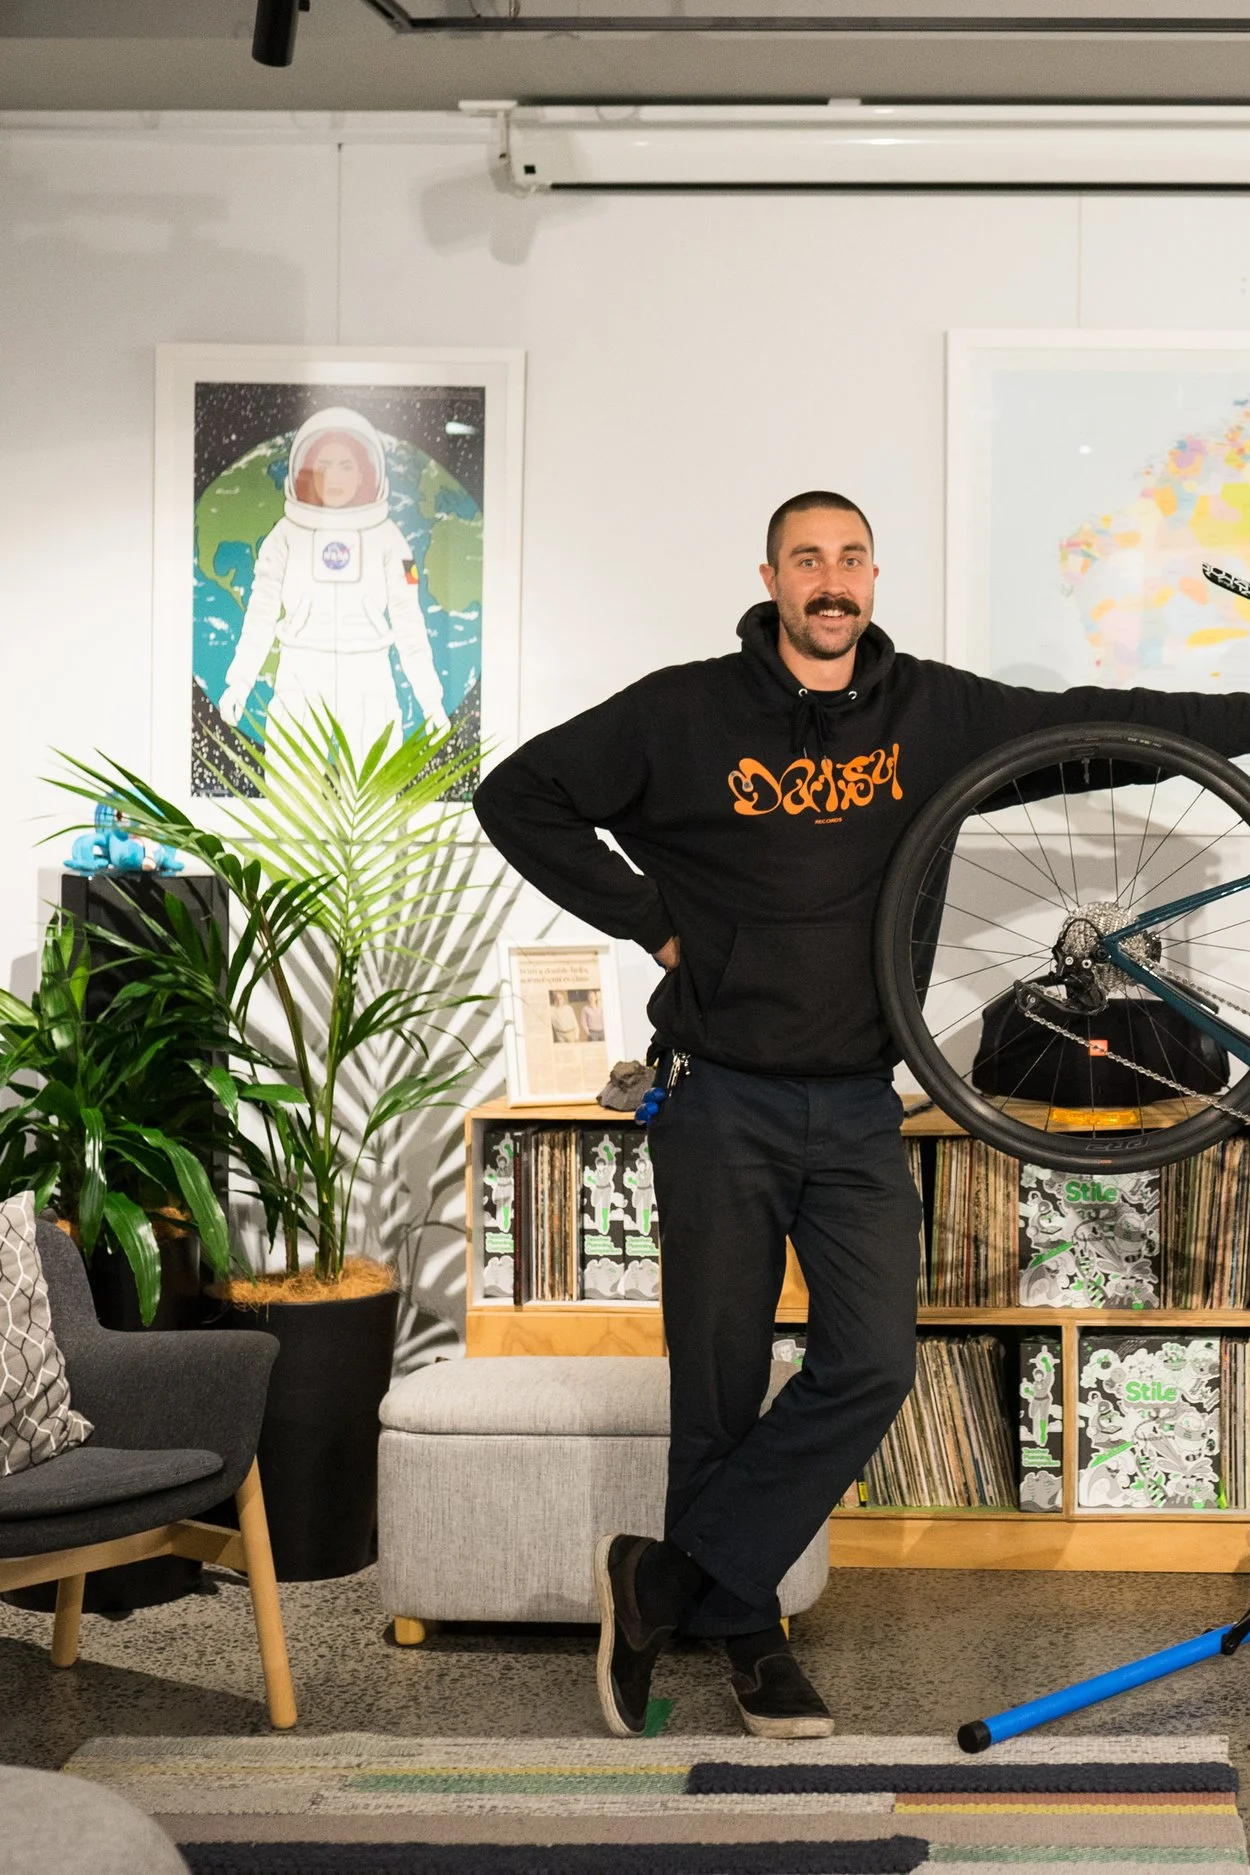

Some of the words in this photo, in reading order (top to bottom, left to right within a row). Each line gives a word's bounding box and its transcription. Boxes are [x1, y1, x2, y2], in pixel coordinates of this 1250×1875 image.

[815, 817, 843, 825] RECORDS
[1065, 1181, 1118, 1201] Stile
[1125, 1381, 1178, 1402] Stile
